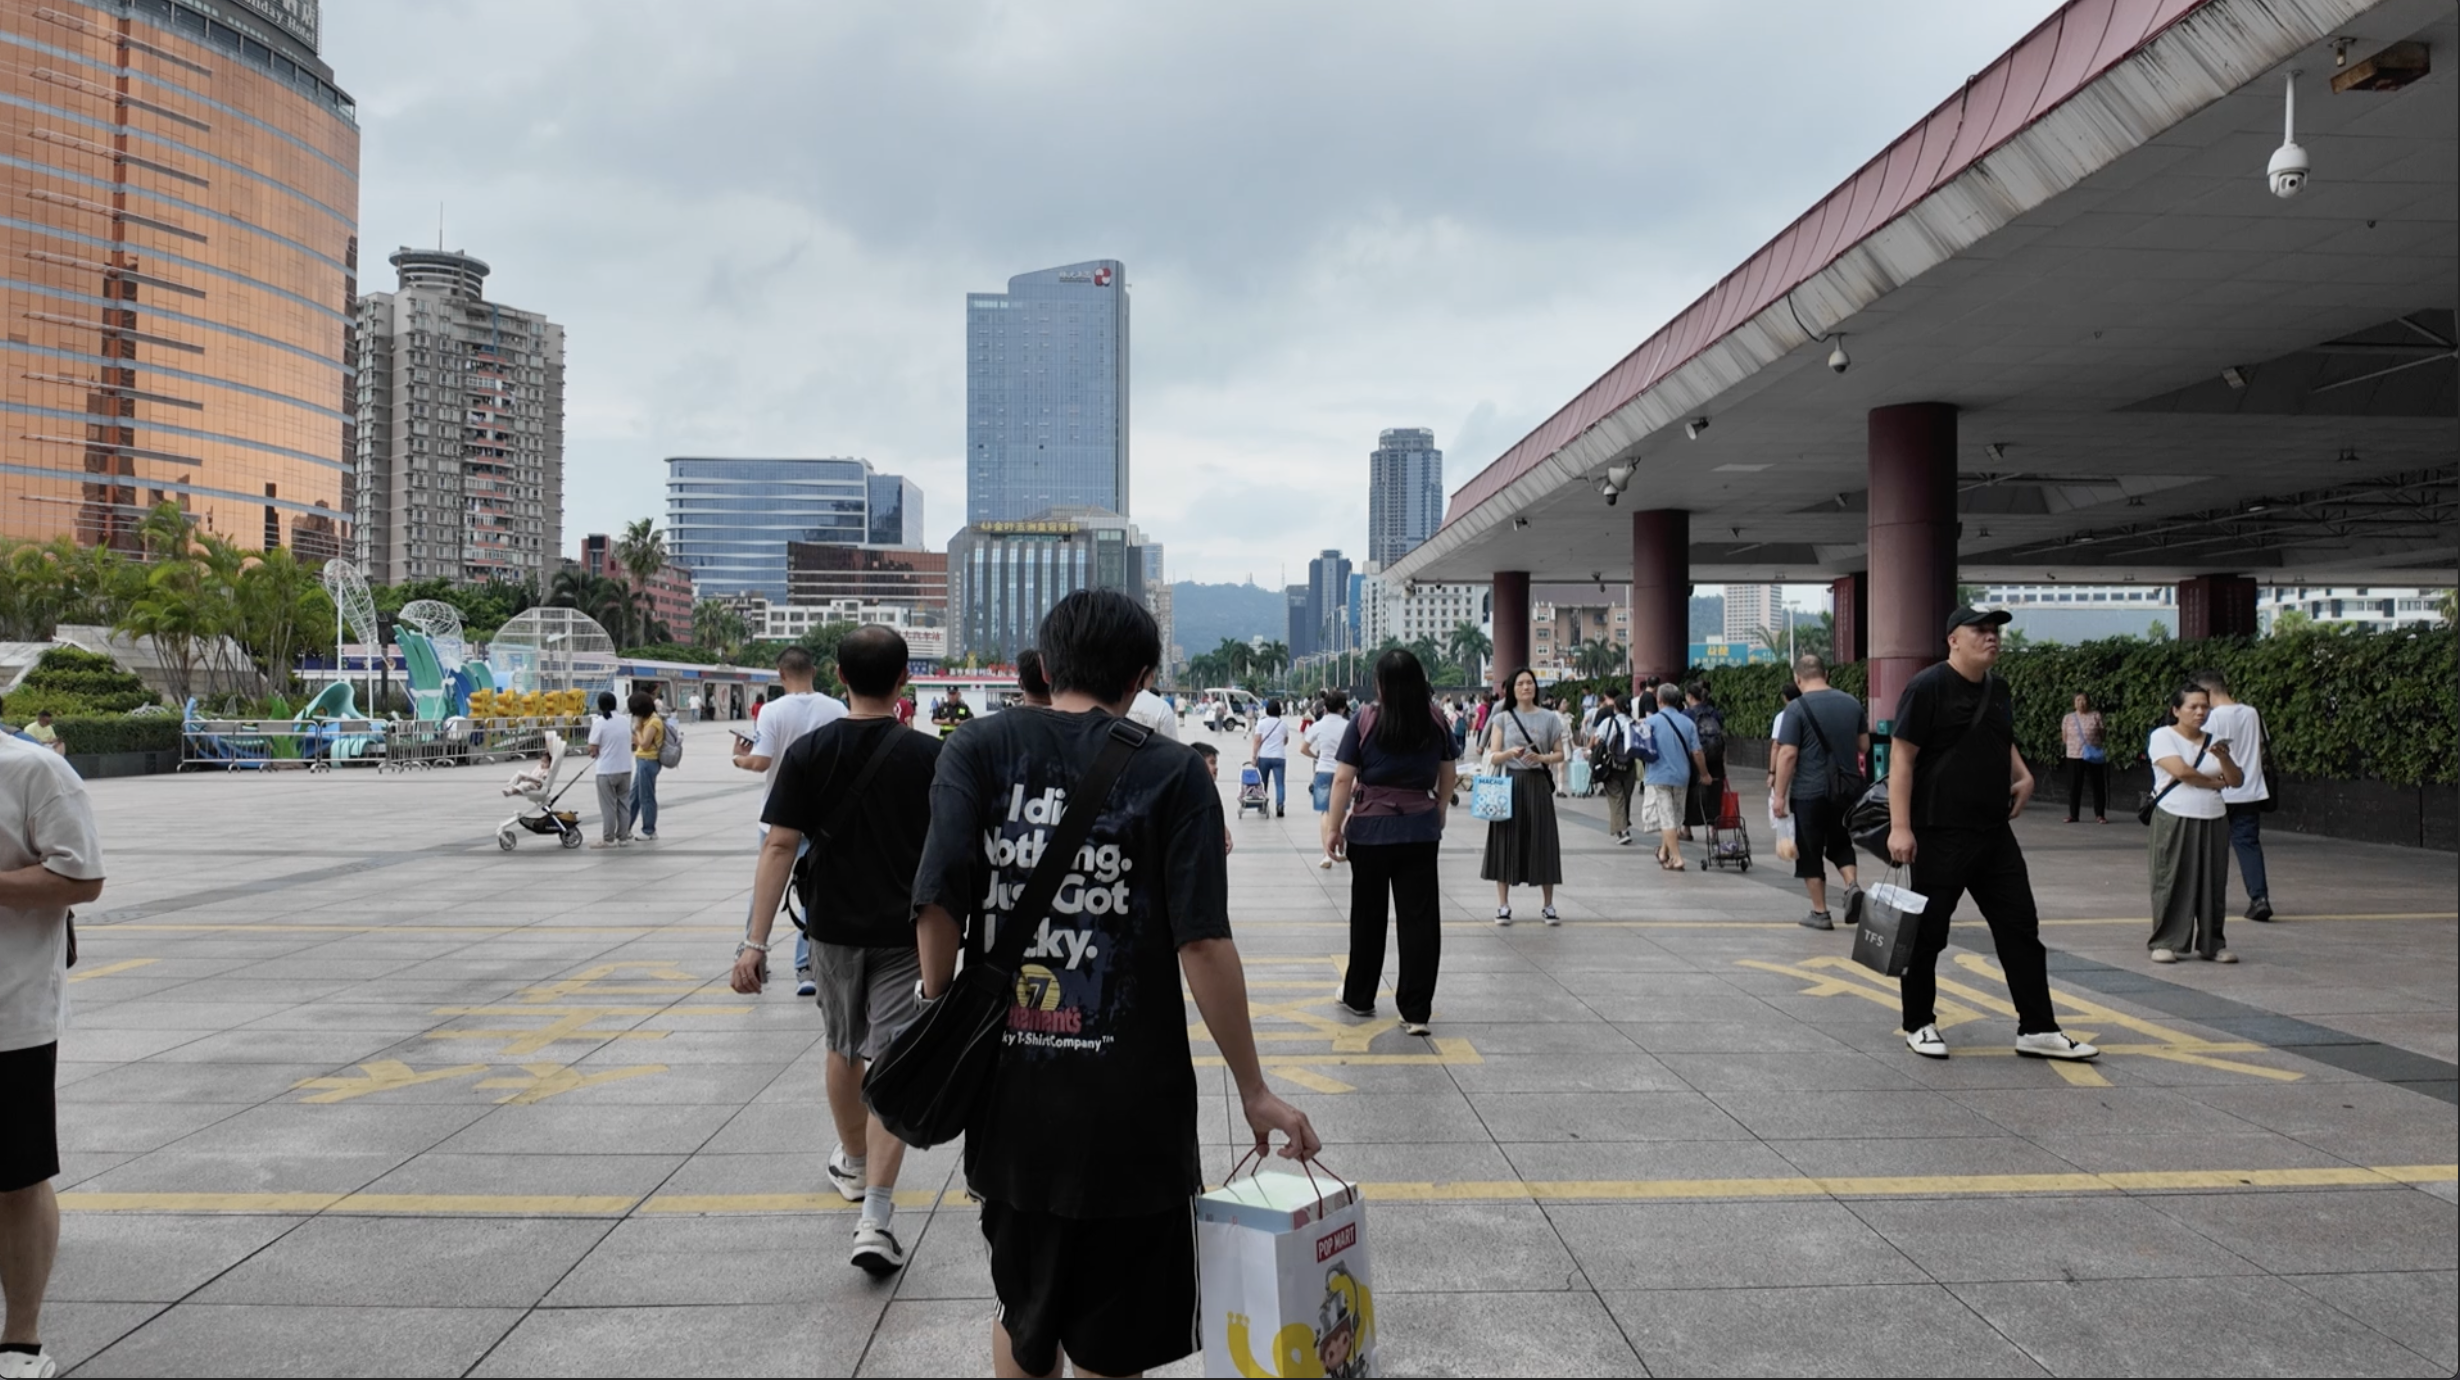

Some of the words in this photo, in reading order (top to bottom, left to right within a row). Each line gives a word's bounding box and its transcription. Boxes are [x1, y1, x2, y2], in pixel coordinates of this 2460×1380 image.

[287, 16, 315, 44] Hotel
[1007, 783, 1025, 822] I
[1024, 787, 1070, 826] di
[984, 826, 1133, 883] Nothng.
[1051, 873, 1130, 915] Got
[1864, 928, 1885, 948] TFS
[1318, 1236, 1333, 1260] POP
[1333, 1225, 1355, 1252] MART
